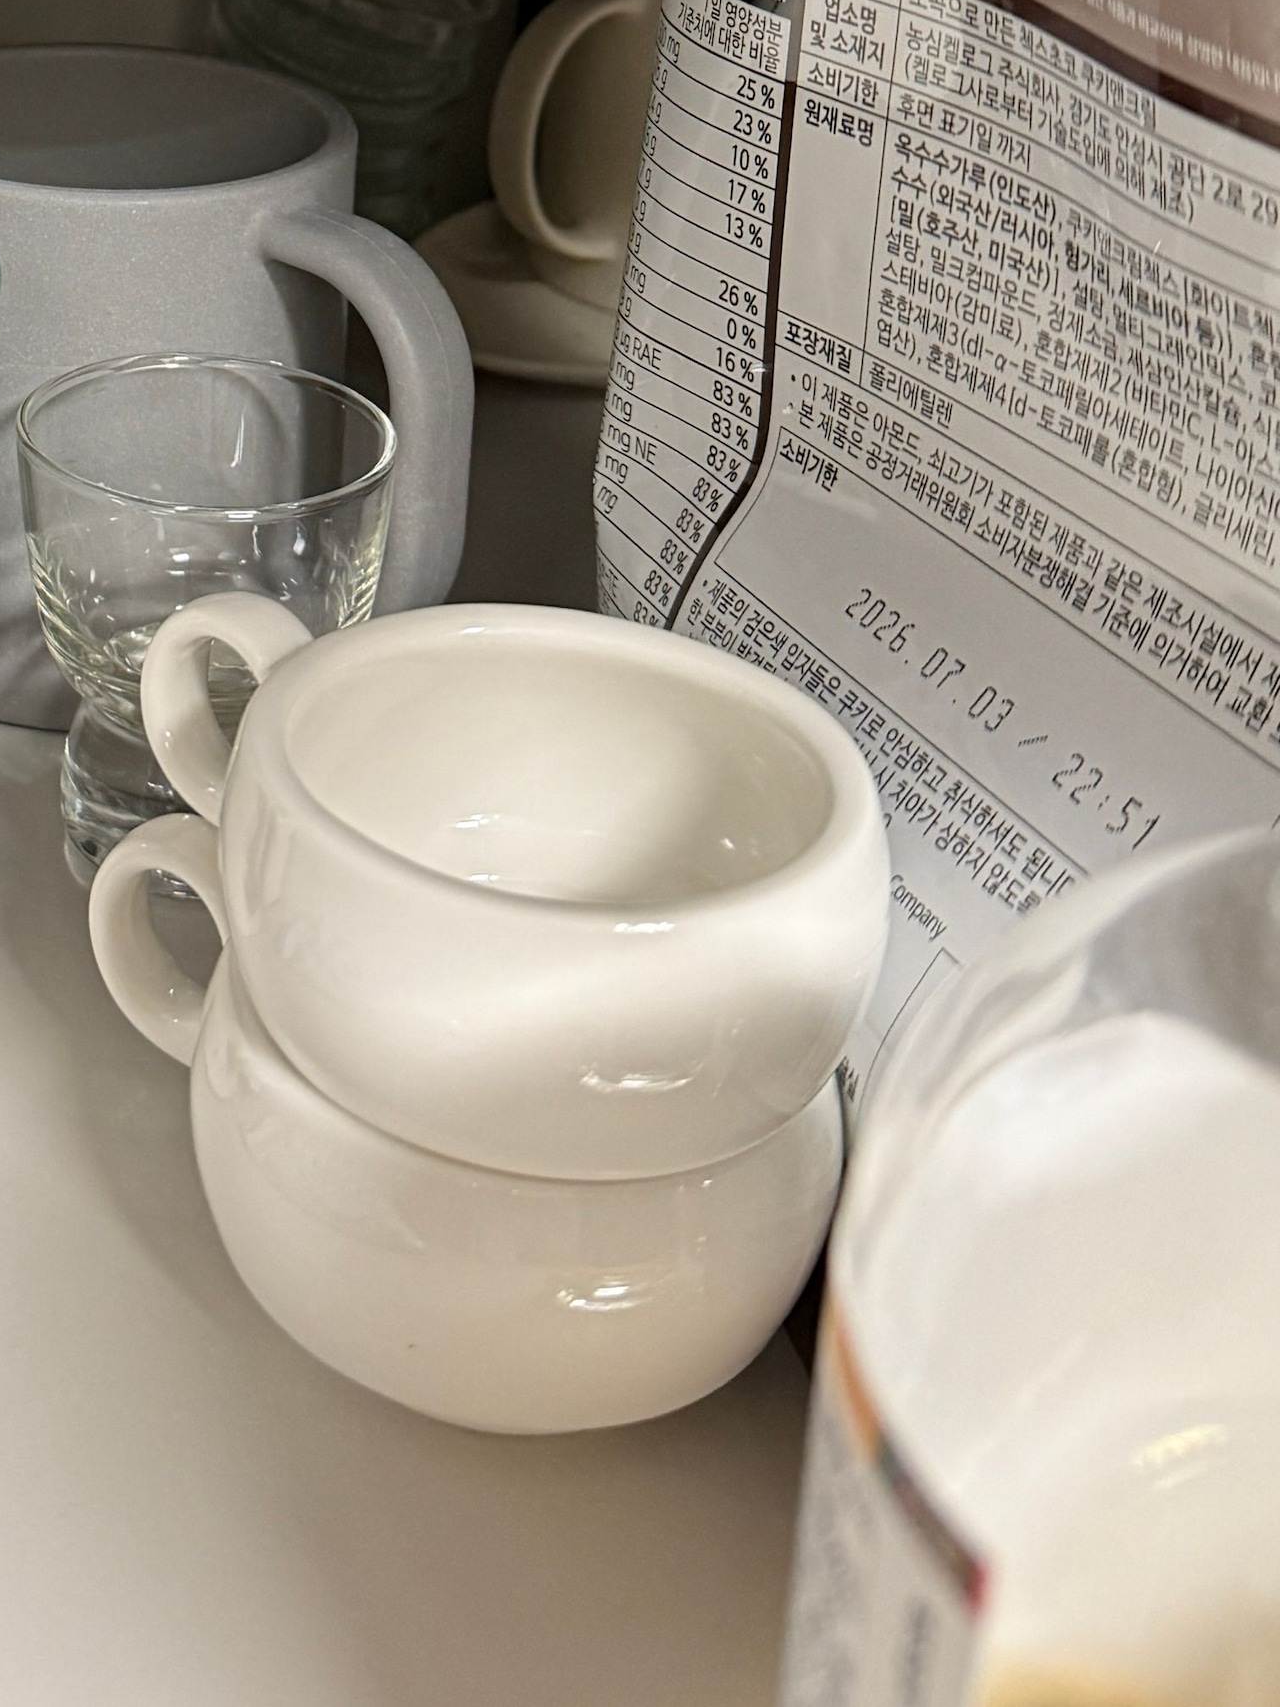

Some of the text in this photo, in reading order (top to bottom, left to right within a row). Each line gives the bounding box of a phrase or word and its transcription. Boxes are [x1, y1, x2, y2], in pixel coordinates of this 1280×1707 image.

[678, 2, 715, 47] 기준치에
[718, 27, 745, 60] 대한
[810, 20, 885, 71] 및 소재지
[906, 21, 993, 77] 농심켈로그
[984, 8, 1016, 48] 만든
[807, 62, 879, 109] 소비기한
[804, 99, 874, 147] 원재료명
[897, 93, 1031, 172] 후면 표기일 까지
[631, 338, 663, 371] RAE
[785, 321, 853, 374] 포장재질
[869, 361, 953, 429] 폴리에틸렌
[634, 436, 659, 464] NE
[780, 438, 838, 493] 소비기한
[798, 399, 815, 430] 본
[817, 412, 863, 460] 제품은
[866, 442, 976, 534] 공정거래위원회
[973, 516, 1095, 614] 소비자분쟁해결
[1093, 593, 1152, 654] 기준에
[1148, 632, 1232, 708] 의거하여
[822, 383, 870, 430] 제품은
[927, 448, 994, 508] 쇠고기가
[994, 489, 1050, 542] 포함된
[1049, 523, 1104, 580] 제품과
[1104, 558, 1144, 605] 같은
[1143, 584, 1264, 684] 제조시설에서
[707, 579, 751, 627] 제품의
[742, 610, 790, 659] 검은색
[781, 643, 841, 705] 입자들은
[839, 689, 886, 741] 쿠키로
[880, 727, 948, 794] 안심하고
[943, 779, 1028, 862] 취식하셔도
[1051, 751, 1161, 853] 22:51
[888, 781, 942, 838] 치아가
[935, 821, 992, 881] 상하지
